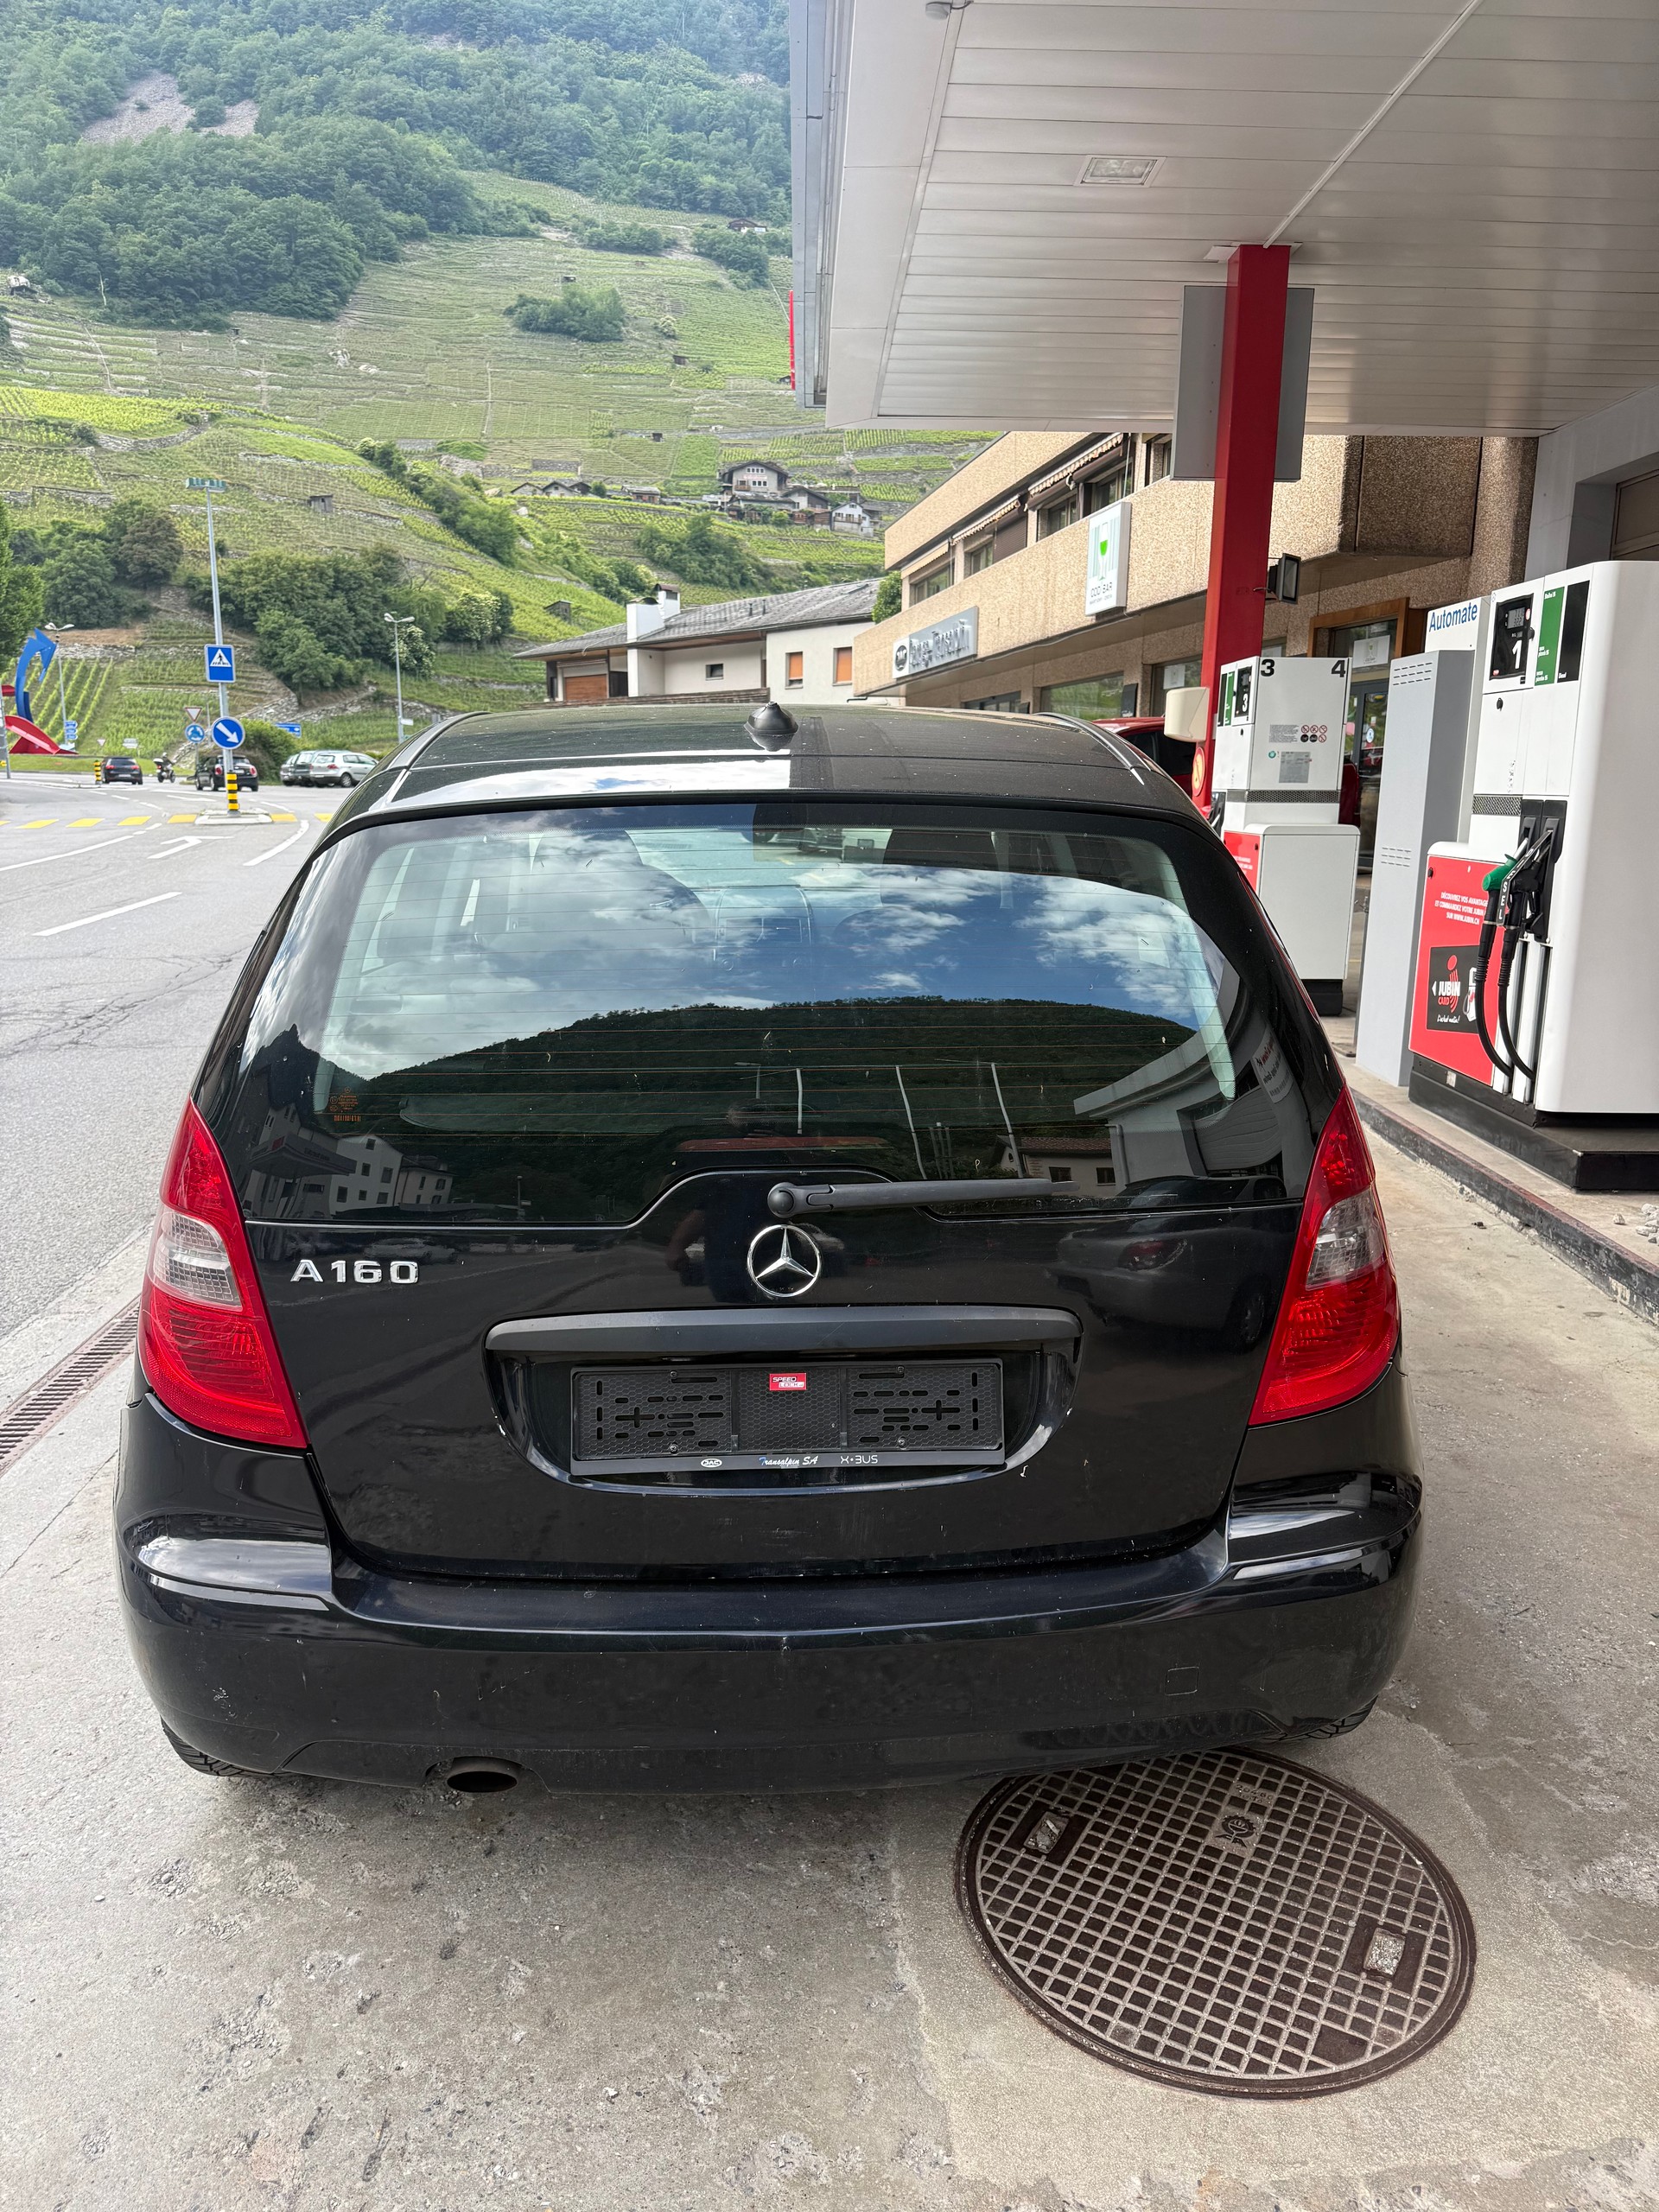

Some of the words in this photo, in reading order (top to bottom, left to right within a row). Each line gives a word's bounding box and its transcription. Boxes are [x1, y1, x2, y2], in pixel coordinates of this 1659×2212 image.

[1429, 602, 1478, 632] Automate
[1512, 639, 1522, 670] 1
[1261, 658, 1275, 677] 3
[1331, 659, 1346, 678] 4
[1242, 693, 1249, 713] 3
[1438, 981, 1460, 996] JUBIN
[1438, 996, 1450, 1005] CARD
[290, 1259, 419, 1284] A160
[759, 1457, 800, 1467] Transalpin
[802, 1456, 819, 1465] SA
